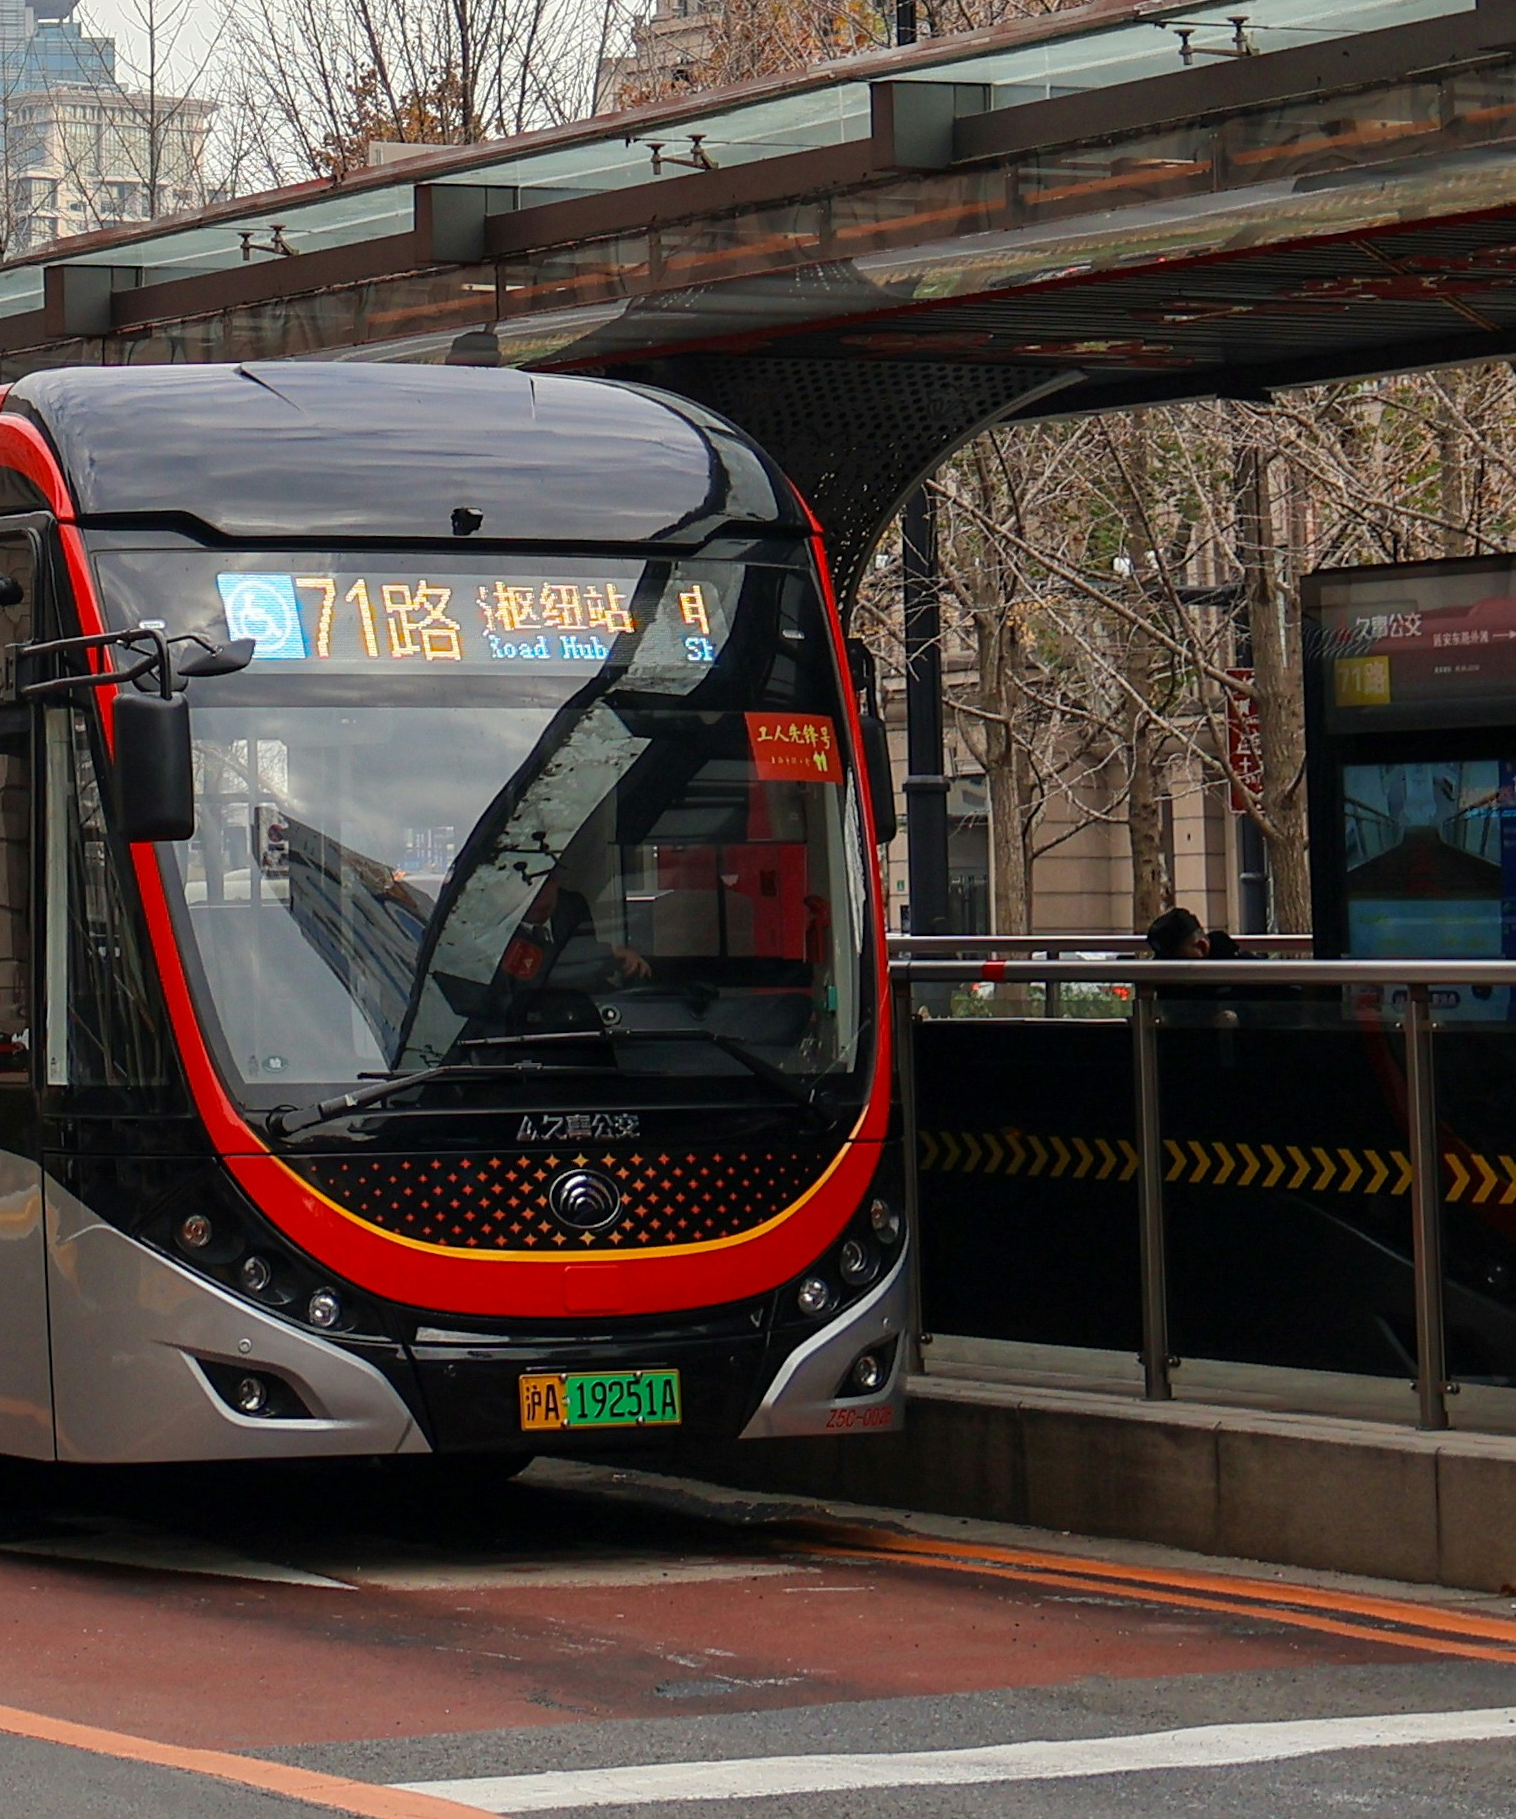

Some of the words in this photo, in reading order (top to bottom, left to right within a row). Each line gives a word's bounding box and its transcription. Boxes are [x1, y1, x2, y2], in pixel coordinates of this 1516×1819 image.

[295, 577, 463, 662] 71路
[559, 635, 610, 660] Hub
[756, 722, 832, 750] 工人先锋号
